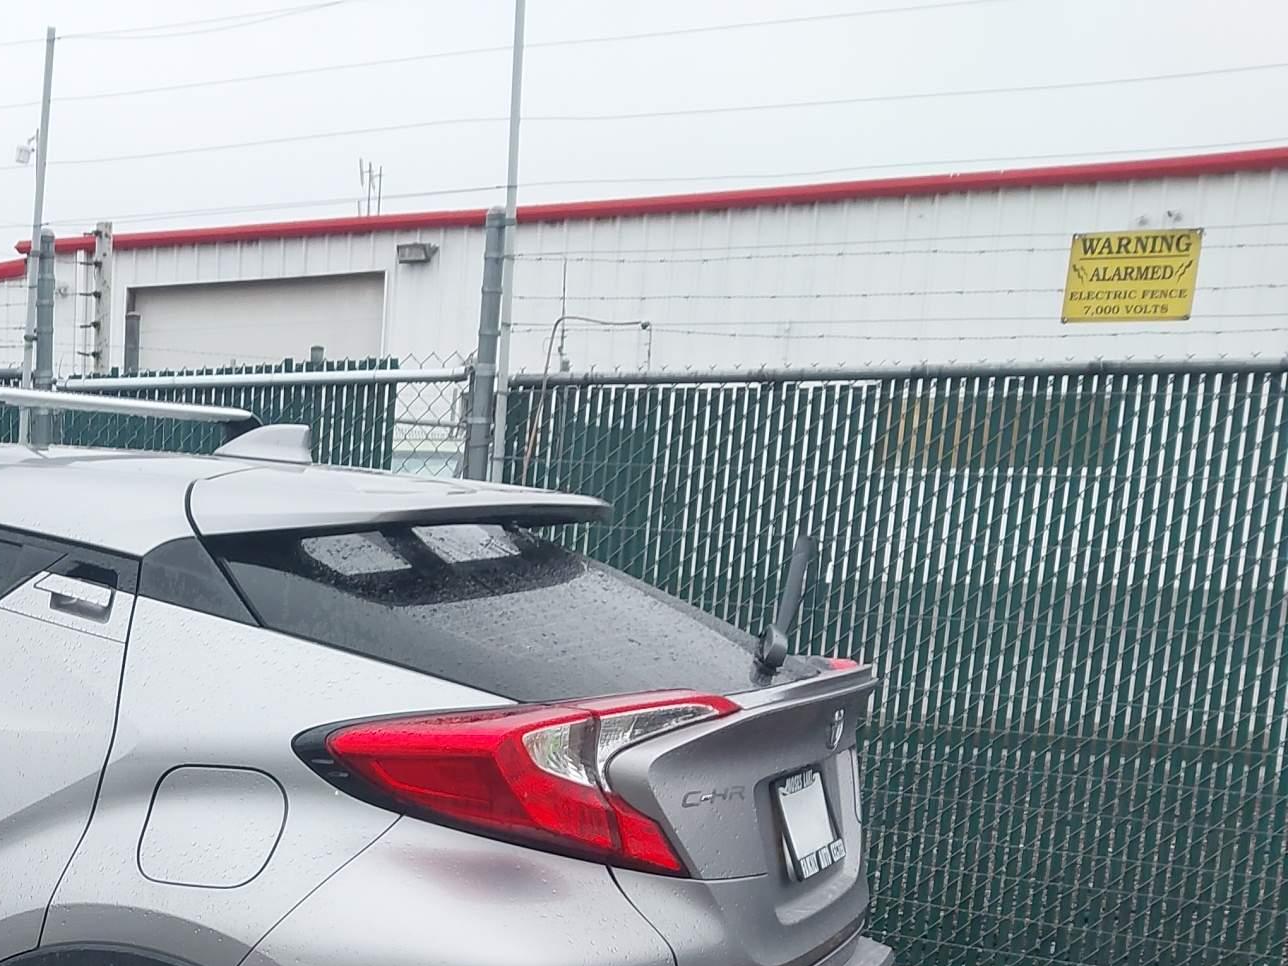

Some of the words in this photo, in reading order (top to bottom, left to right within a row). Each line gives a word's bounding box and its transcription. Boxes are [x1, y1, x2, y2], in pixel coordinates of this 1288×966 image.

[1080, 234, 1193, 256] WARNING
[1089, 264, 1174, 282] ALARMED
[1069, 289, 1139, 301] ELECTRIC
[1141, 288, 1188, 300] FENCE
[1083, 305, 1120, 317] 7,000
[1124, 304, 1169, 315] VOLTS
[681, 785, 745, 808] C-HR
